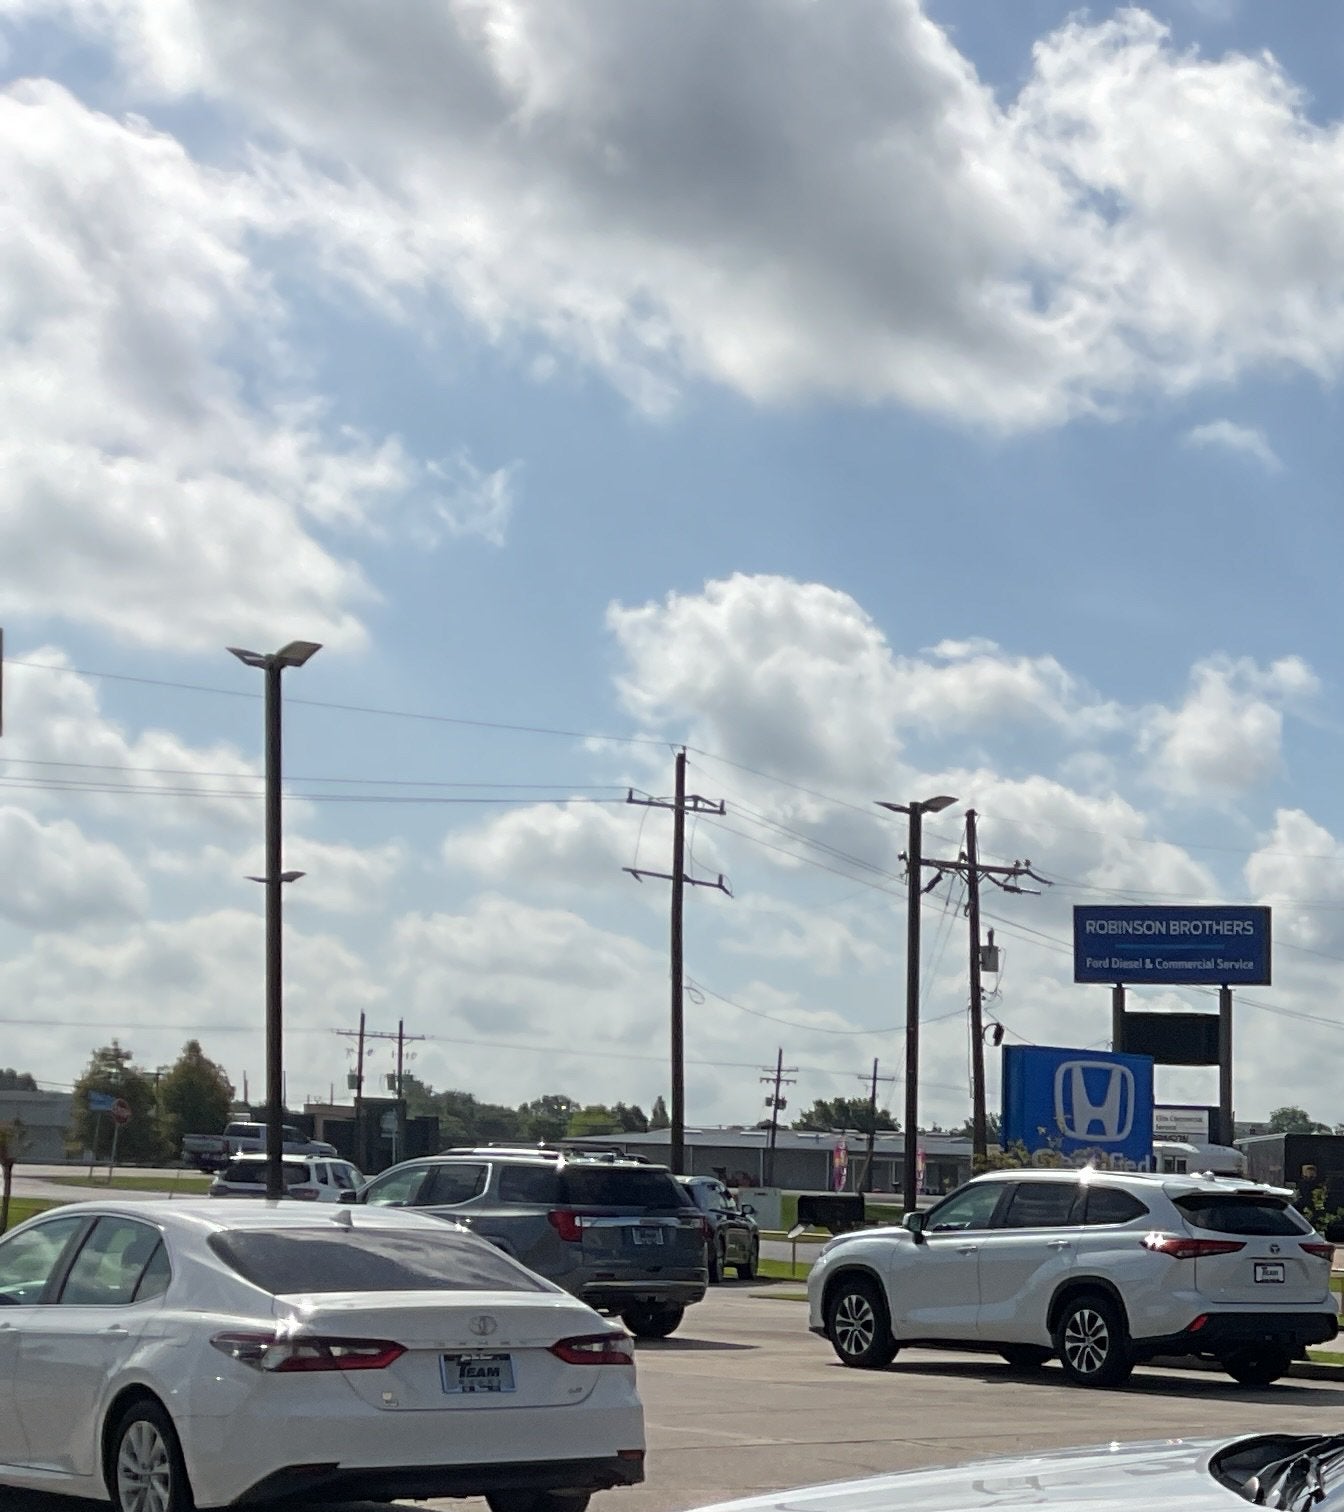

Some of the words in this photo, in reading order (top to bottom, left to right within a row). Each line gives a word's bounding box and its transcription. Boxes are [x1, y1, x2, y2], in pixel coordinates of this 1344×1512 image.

[1085, 920, 1167, 935] ROBINSON
[1169, 920, 1254, 935] BROTHERS
[1086, 958, 1109, 969] Ford
[1111, 958, 1143, 969] Diesel
[1145, 959, 1153, 969] &
[1155, 958, 1215, 969] Commercial
[1216, 958, 1254, 970] Service
[456, 1361, 501, 1378] TEAM
